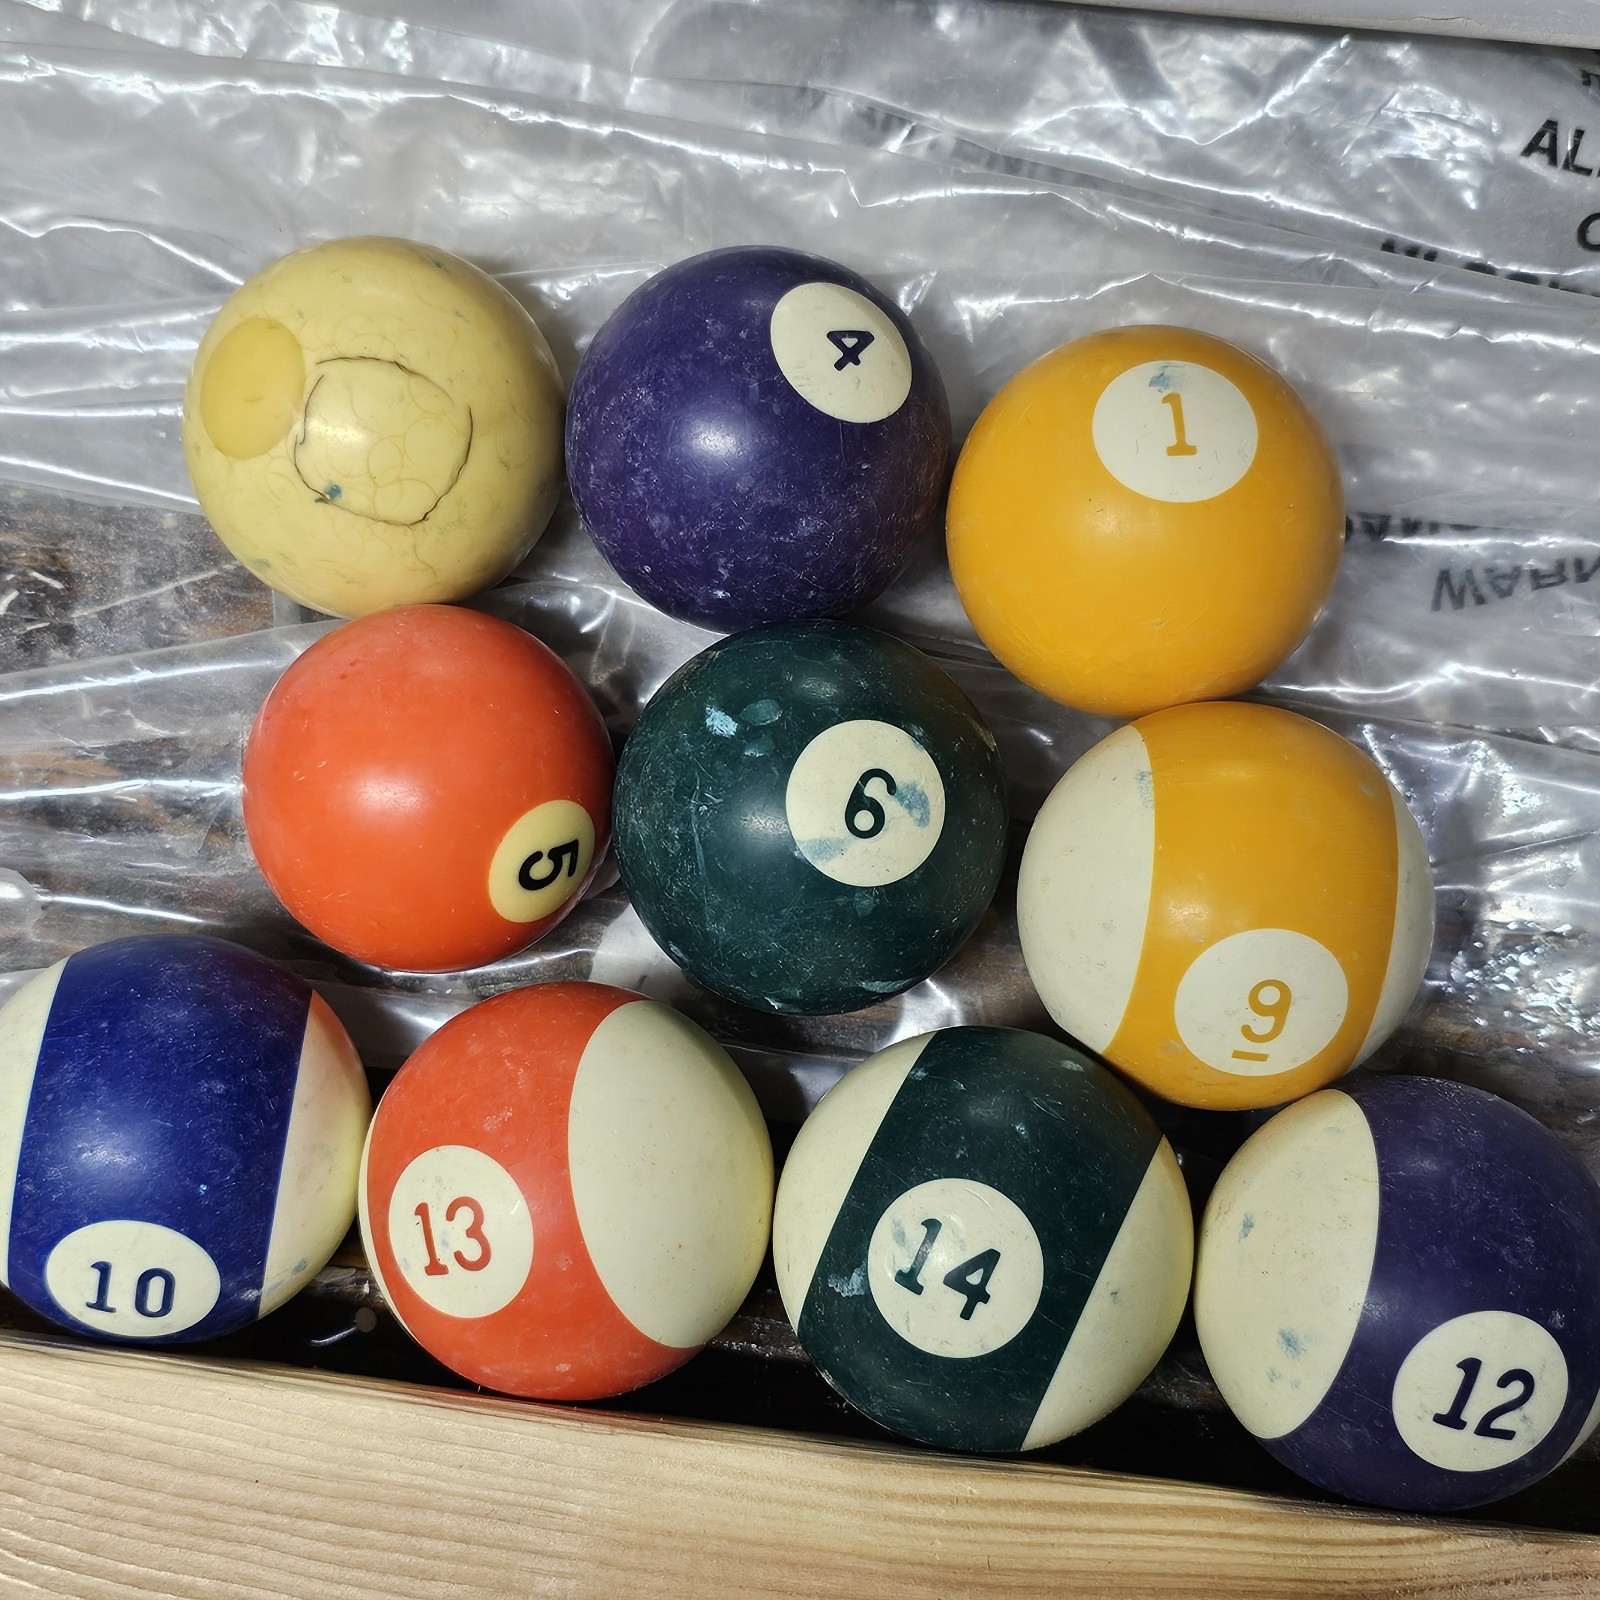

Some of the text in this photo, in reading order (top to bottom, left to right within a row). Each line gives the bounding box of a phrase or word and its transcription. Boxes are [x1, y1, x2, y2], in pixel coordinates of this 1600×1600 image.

[1520, 119, 1600, 178] AL
[826, 329, 875, 370] 4
[1161, 391, 1195, 456] 1
[845, 767, 897, 838] 6
[518, 840, 580, 893] 5
[1238, 979, 1290, 1048] 9
[413, 1196, 491, 1276] 13
[893, 1218, 1001, 1319] 14
[85, 1260, 176, 1318] 10
[1433, 1357, 1535, 1438] 12
